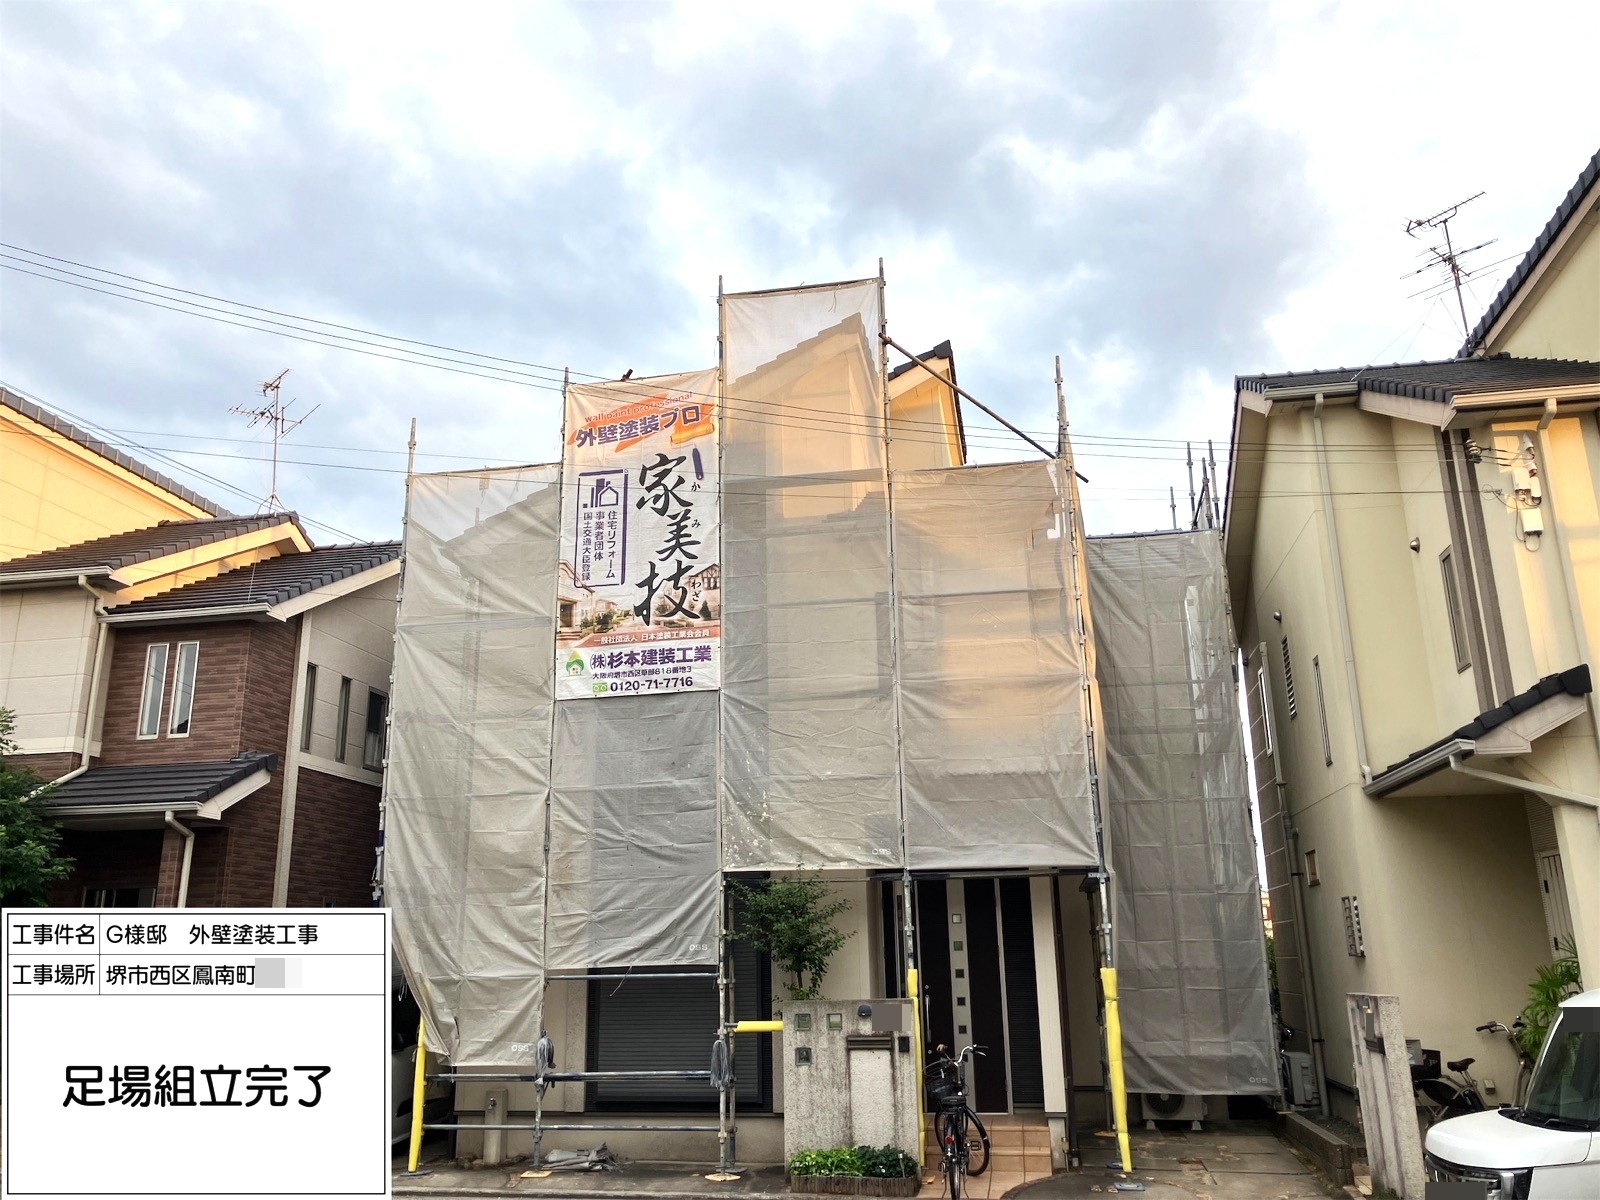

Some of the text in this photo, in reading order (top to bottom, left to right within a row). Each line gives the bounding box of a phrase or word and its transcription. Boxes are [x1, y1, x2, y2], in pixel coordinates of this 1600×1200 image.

[575, 405, 701, 448] 外壁塗装プロ
[606, 408, 632, 421] paint
[634, 392, 694, 414] professional
[581, 512, 593, 581] 国土交通大臣登録
[594, 511, 605, 561] 事業者団体
[606, 510, 618, 579] 住宅リフォーム
[634, 453, 702, 626] 家美技
[690, 481, 702, 602] か み わざ
[610, 676, 693, 692] 0120-71-7716
